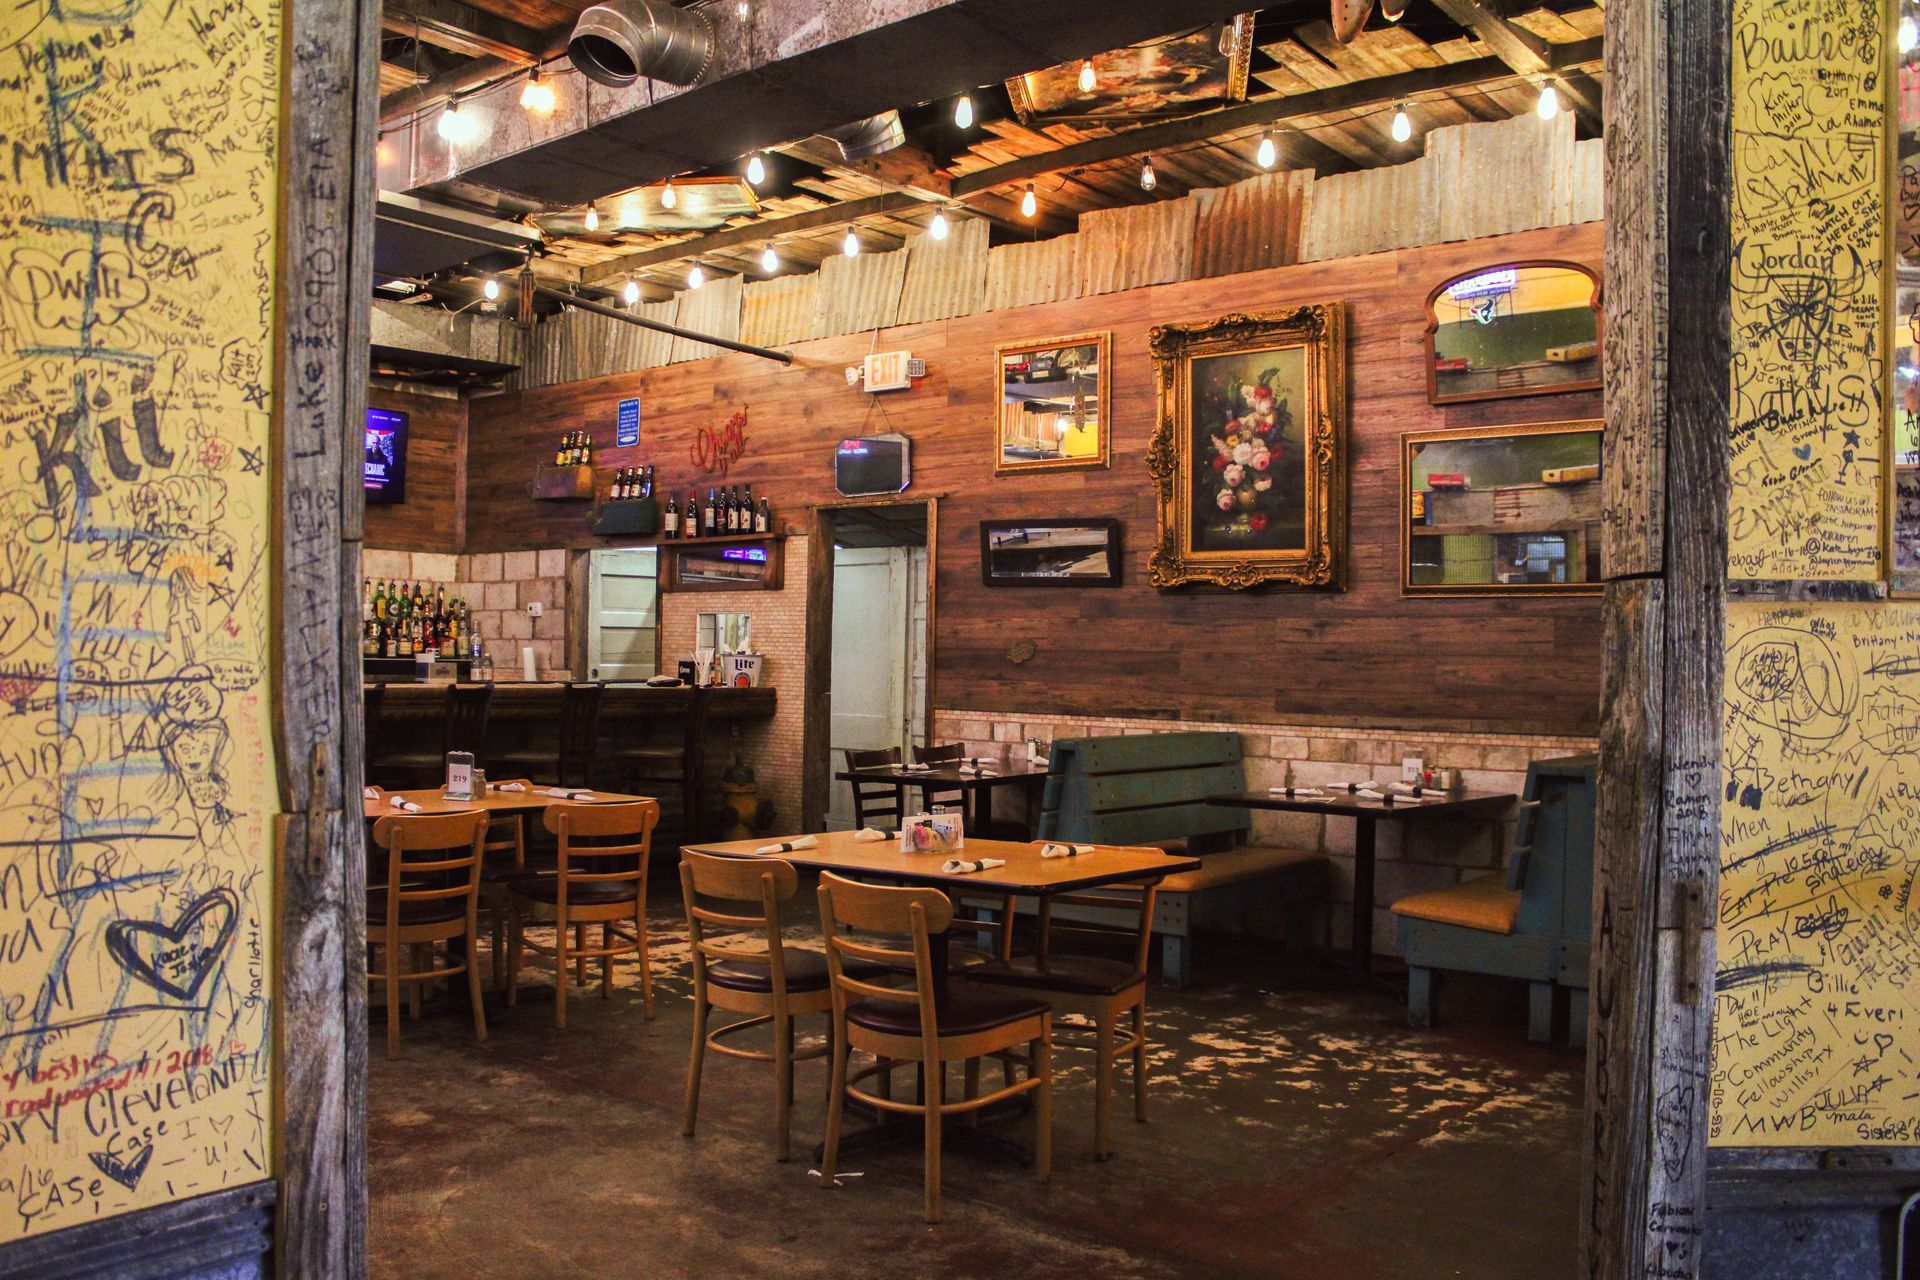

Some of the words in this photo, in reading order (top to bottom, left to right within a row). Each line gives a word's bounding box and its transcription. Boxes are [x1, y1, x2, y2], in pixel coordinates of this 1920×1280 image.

[1749, 240, 1836, 275] Jordan
[870, 354, 900, 386] EXIT
[734, 658, 755, 672] Lite
